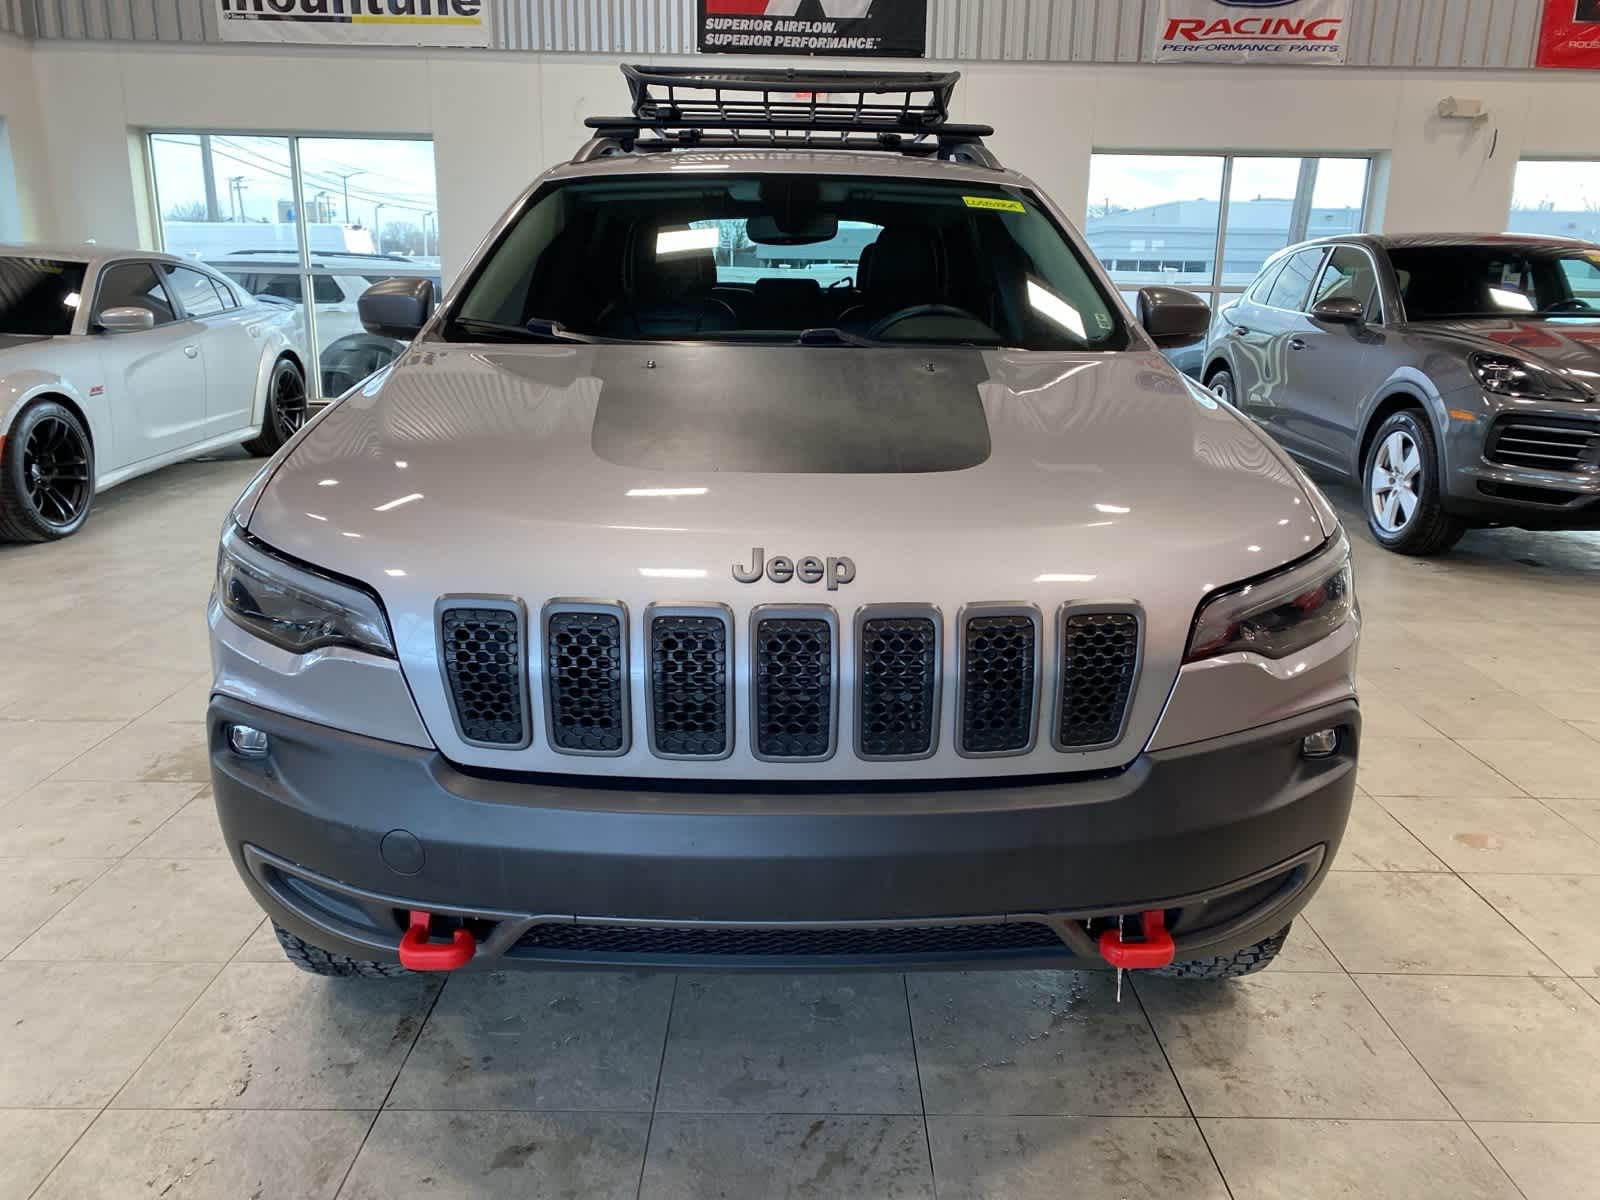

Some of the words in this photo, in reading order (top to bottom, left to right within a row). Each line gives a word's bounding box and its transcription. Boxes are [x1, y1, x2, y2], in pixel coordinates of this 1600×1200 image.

[705, 18, 773, 32] SUPERIOR
[774, 20, 837, 34] AIRFLOW.
[1163, 18, 1343, 41] RACING
[705, 33, 774, 47] SUPERIOR
[1162, 43, 1287, 52] PERFORMANCE
[1288, 44, 1339, 53] PARTS
[732, 547, 857, 591] Jeep
